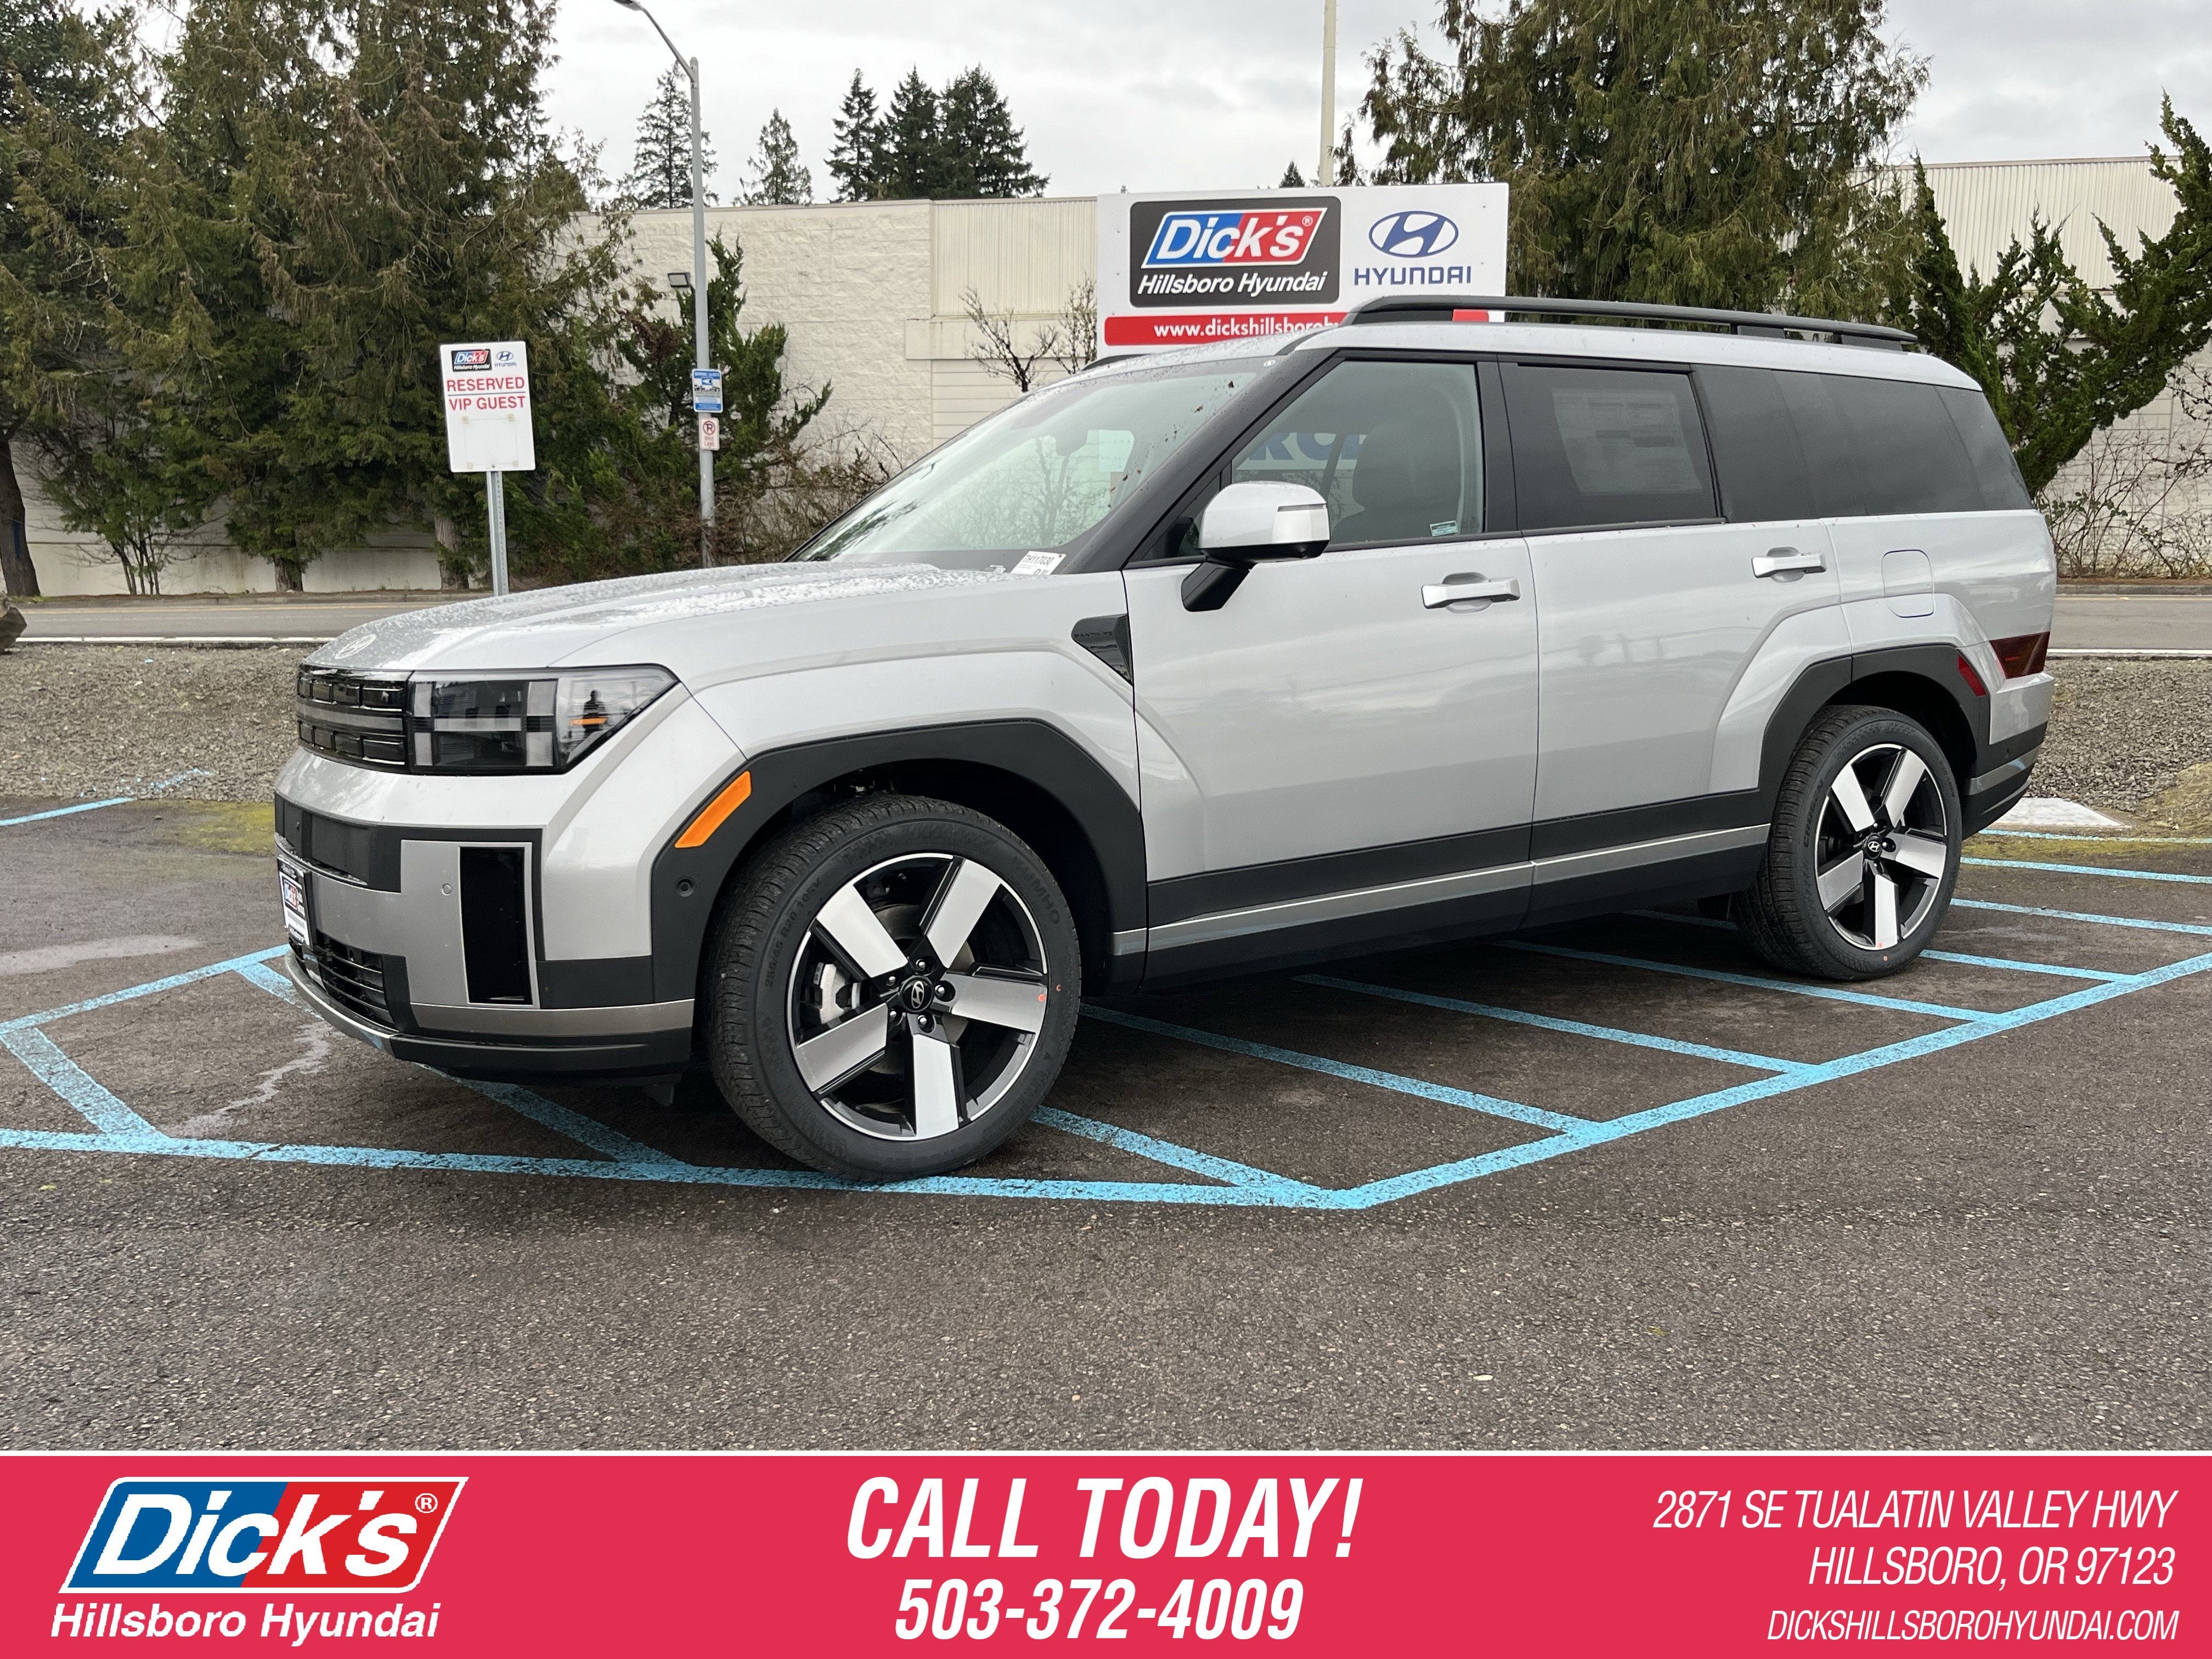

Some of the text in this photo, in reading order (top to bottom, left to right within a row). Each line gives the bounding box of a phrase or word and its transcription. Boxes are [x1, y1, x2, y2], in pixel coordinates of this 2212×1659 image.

[1156, 215, 1304, 259] Dick's
[1137, 271, 1328, 298] Hillsboro Hyundai
[1354, 266, 1471, 286] HYUNDAI
[456, 352, 485, 363] Dick's
[447, 377, 525, 392] RESERVED
[449, 396, 526, 411] VIP GUEST
